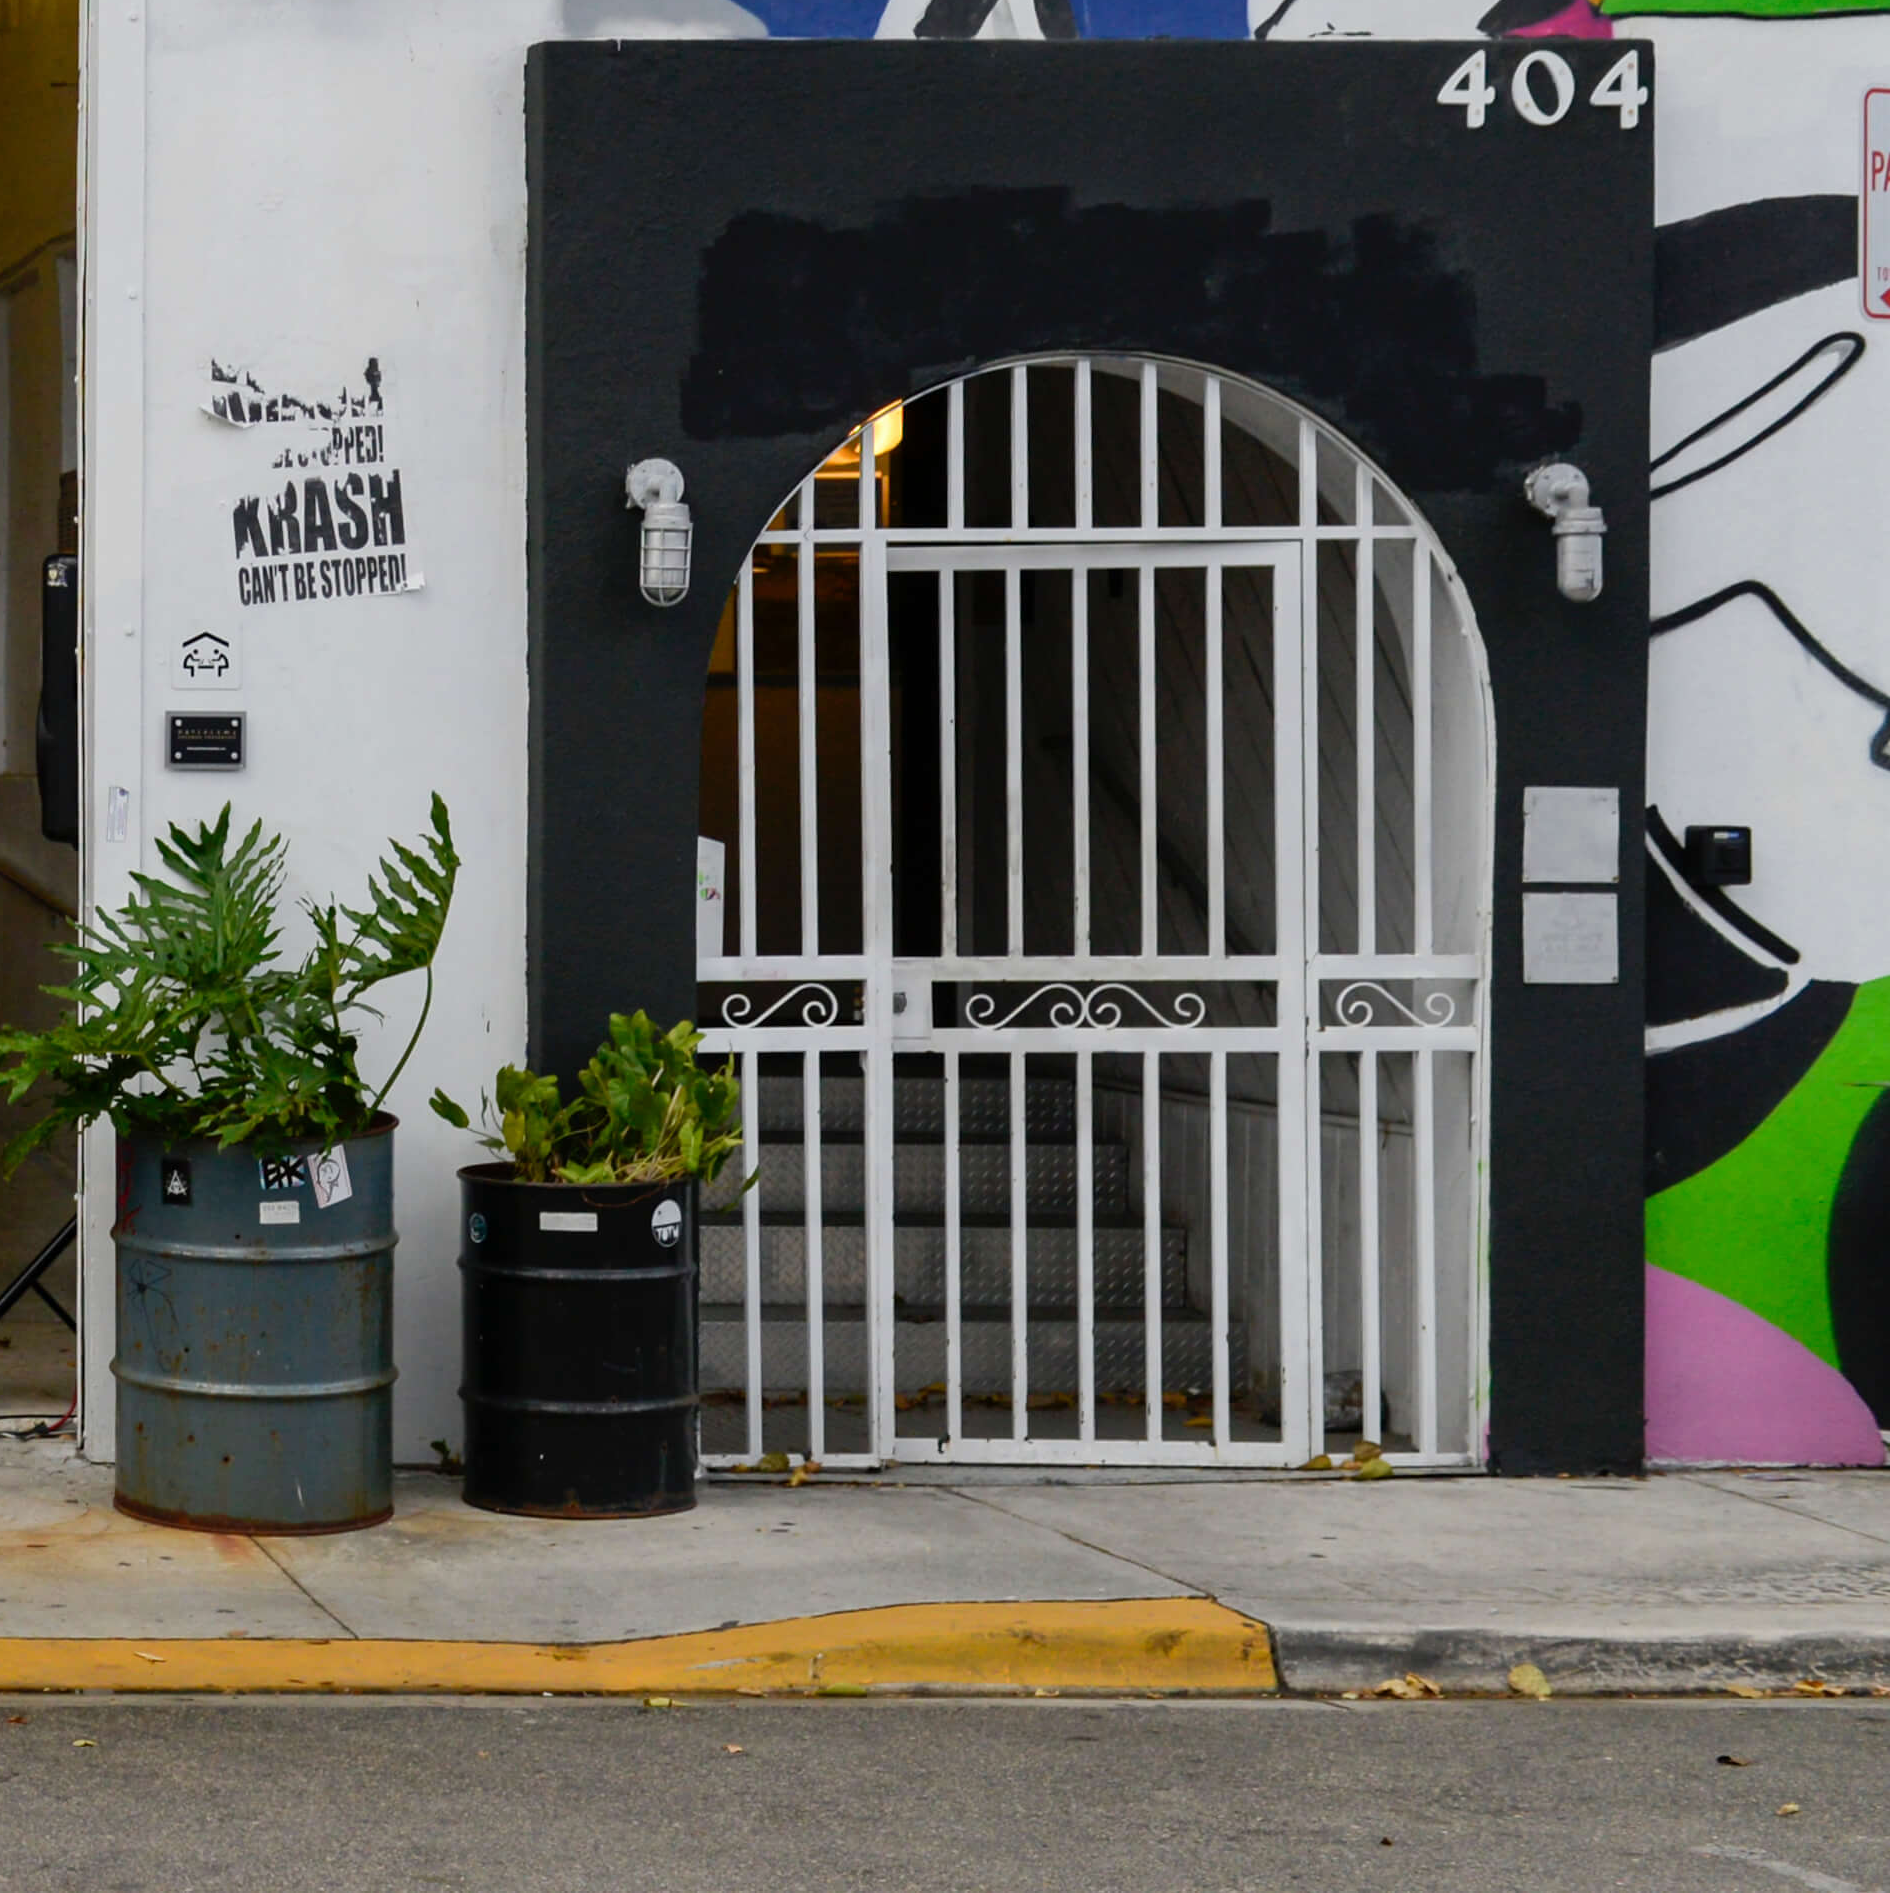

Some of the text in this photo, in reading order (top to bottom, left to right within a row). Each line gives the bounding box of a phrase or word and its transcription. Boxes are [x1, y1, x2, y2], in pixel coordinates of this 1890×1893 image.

[1437, 50, 1648, 128] 404
[232, 469, 406, 559] KRASH
[238, 553, 408, 606] CAN'T BE STOPPED!
